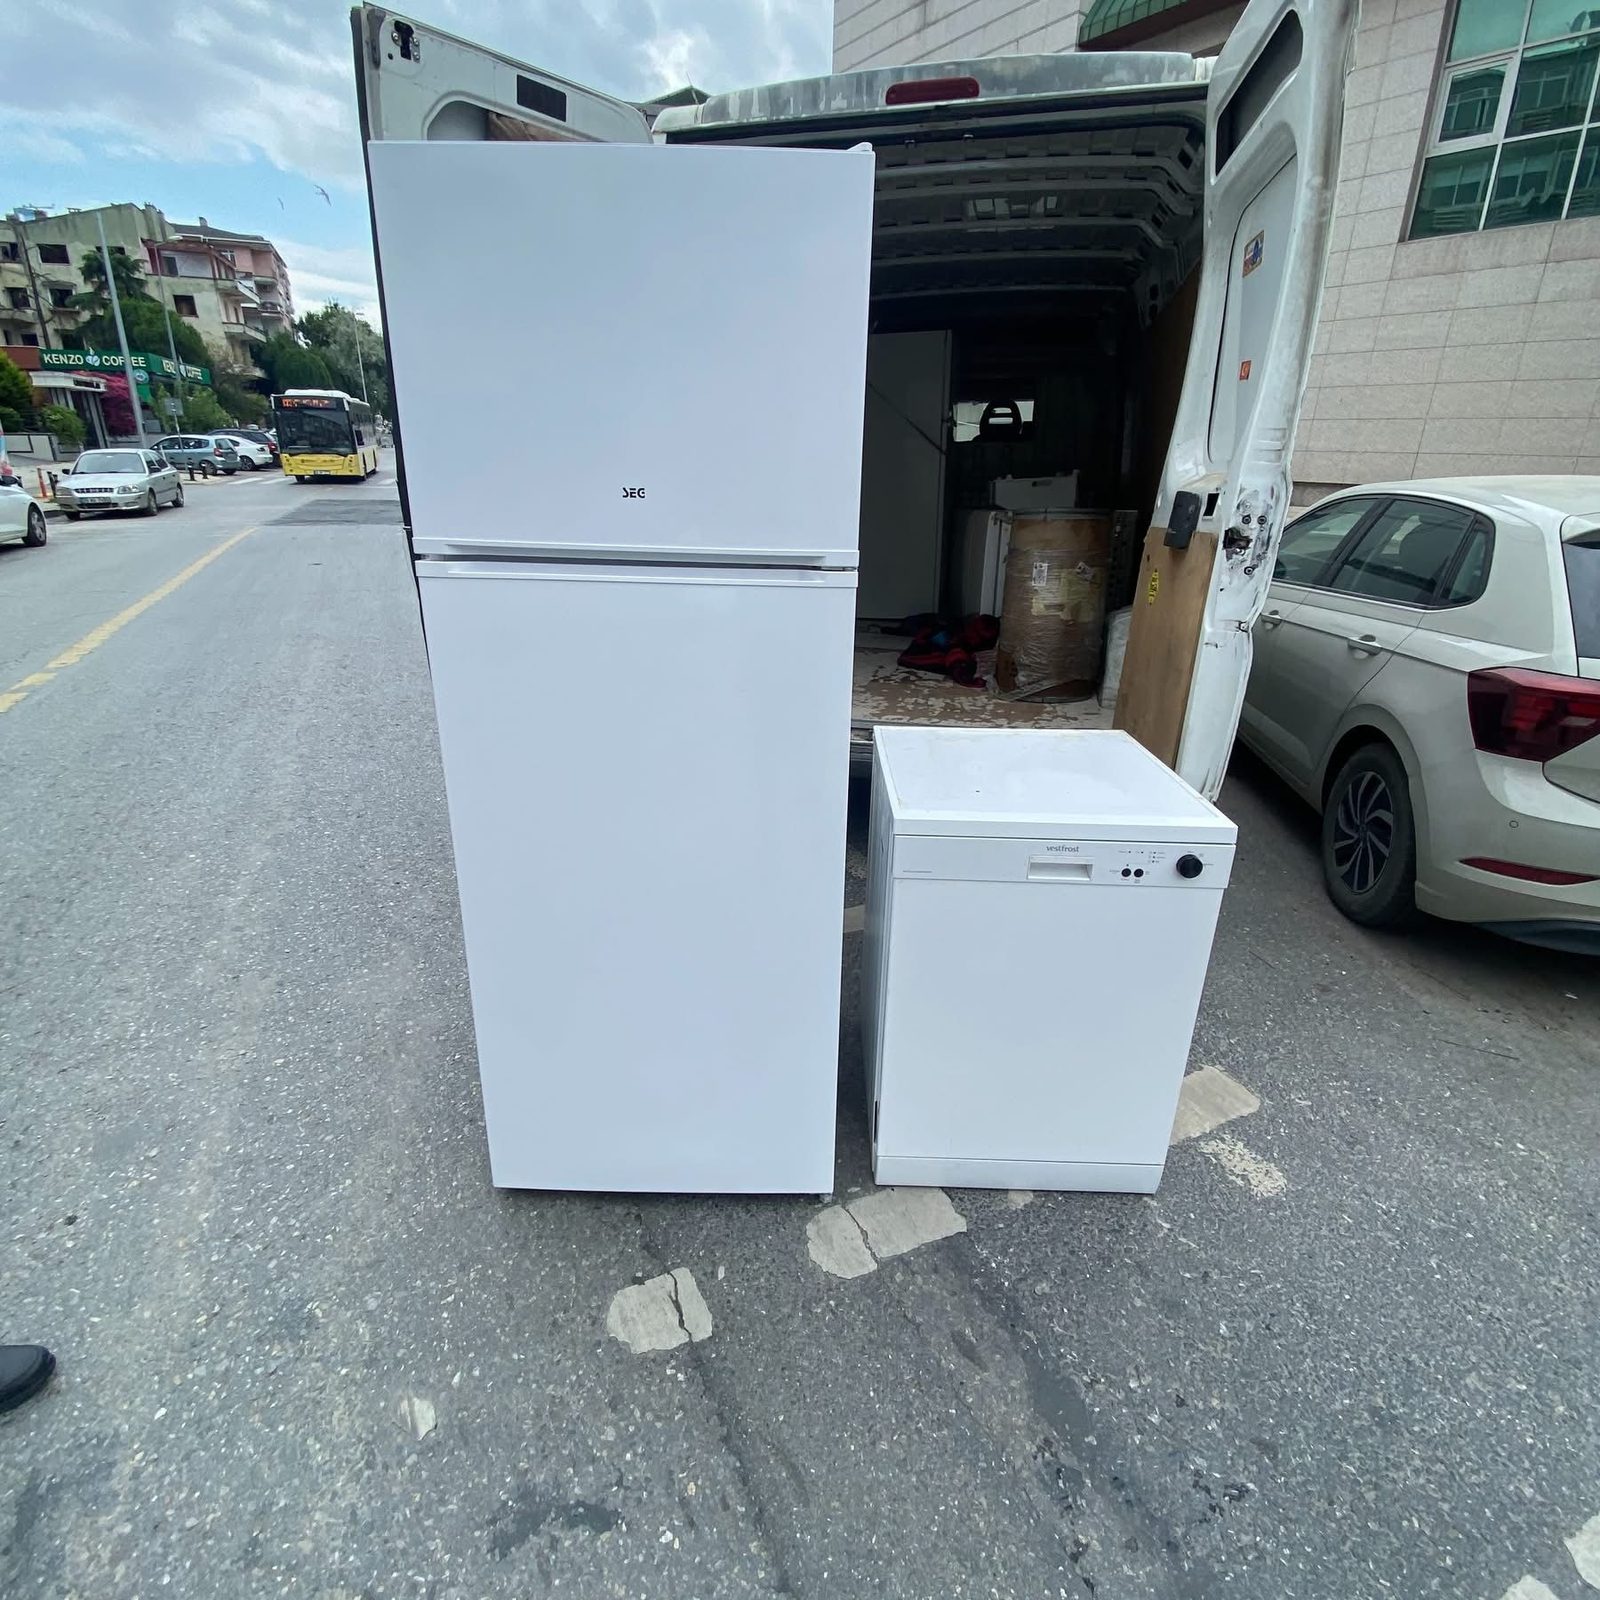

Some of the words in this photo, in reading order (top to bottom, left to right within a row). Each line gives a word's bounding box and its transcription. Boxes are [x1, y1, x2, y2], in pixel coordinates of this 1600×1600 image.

[43, 354, 84, 365] KENZO
[102, 355, 147, 367] COFEE
[162, 359, 176, 374] KENZ
[622, 487, 646, 499] SEG
[1046, 844, 1079, 854] vestfrost
